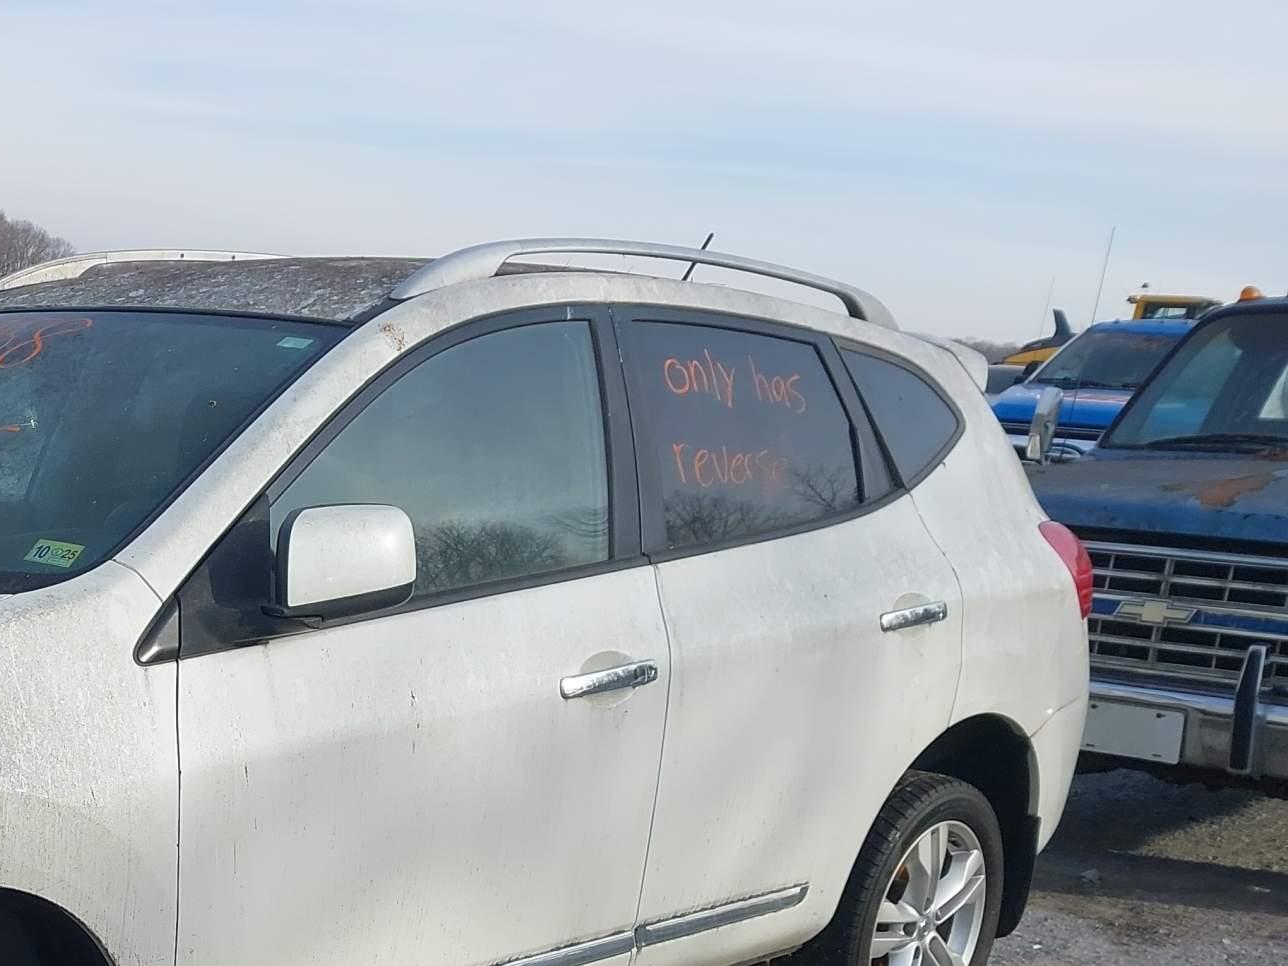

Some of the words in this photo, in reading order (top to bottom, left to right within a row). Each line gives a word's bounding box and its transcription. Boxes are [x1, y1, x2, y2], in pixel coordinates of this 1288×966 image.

[664, 348, 736, 408] only
[748, 354, 806, 414] has
[33, 545, 51, 558] 10
[61, 549, 78, 560] 25
